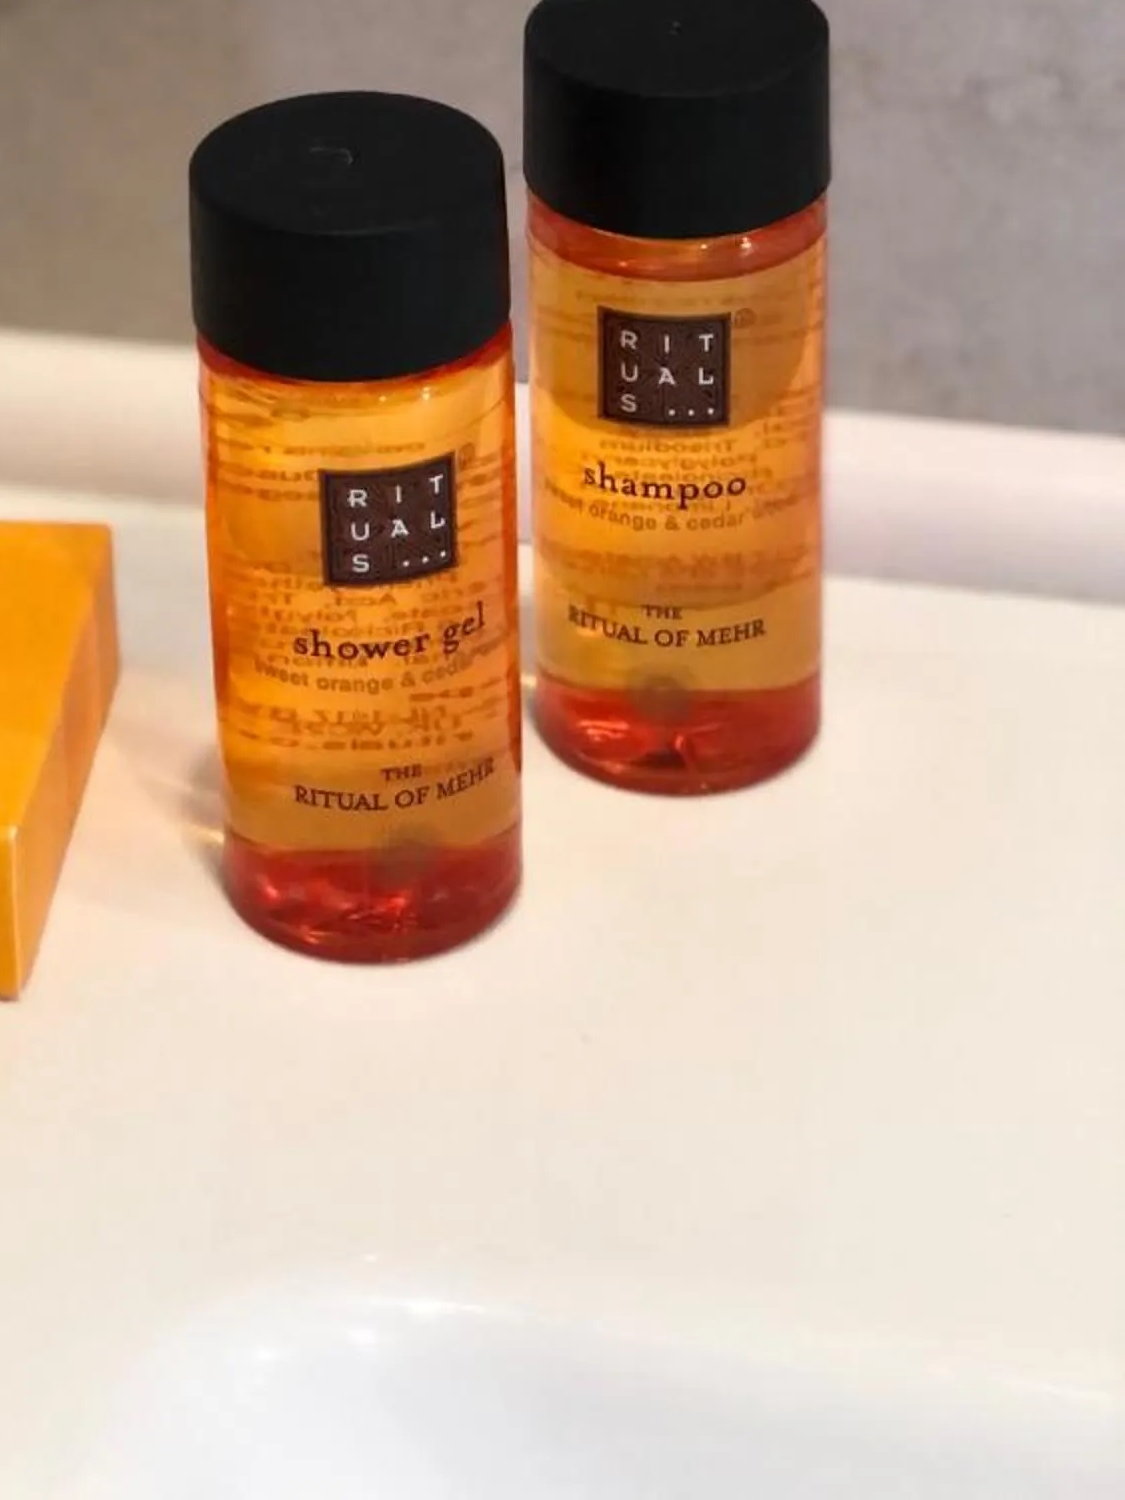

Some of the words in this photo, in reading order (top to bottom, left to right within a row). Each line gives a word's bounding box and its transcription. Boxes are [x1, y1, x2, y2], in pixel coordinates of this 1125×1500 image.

[584, 460, 747, 510] shampoo
[588, 501, 658, 532] orange
[664, 516, 681, 531] &
[686, 509, 745, 531] cedar
[293, 627, 432, 660] shower
[441, 599, 487, 655] gel
[567, 603, 648, 646] RITUAL
[654, 628, 691, 648] OF
[695, 617, 767, 648] MEHR
[640, 604, 683, 620] THE
[316, 674, 394, 695] orange
[400, 670, 416, 689] &
[294, 784, 389, 812] RITUAL
[394, 785, 431, 809] OF
[436, 756, 495, 800] MEHR
[380, 763, 422, 782] THE
